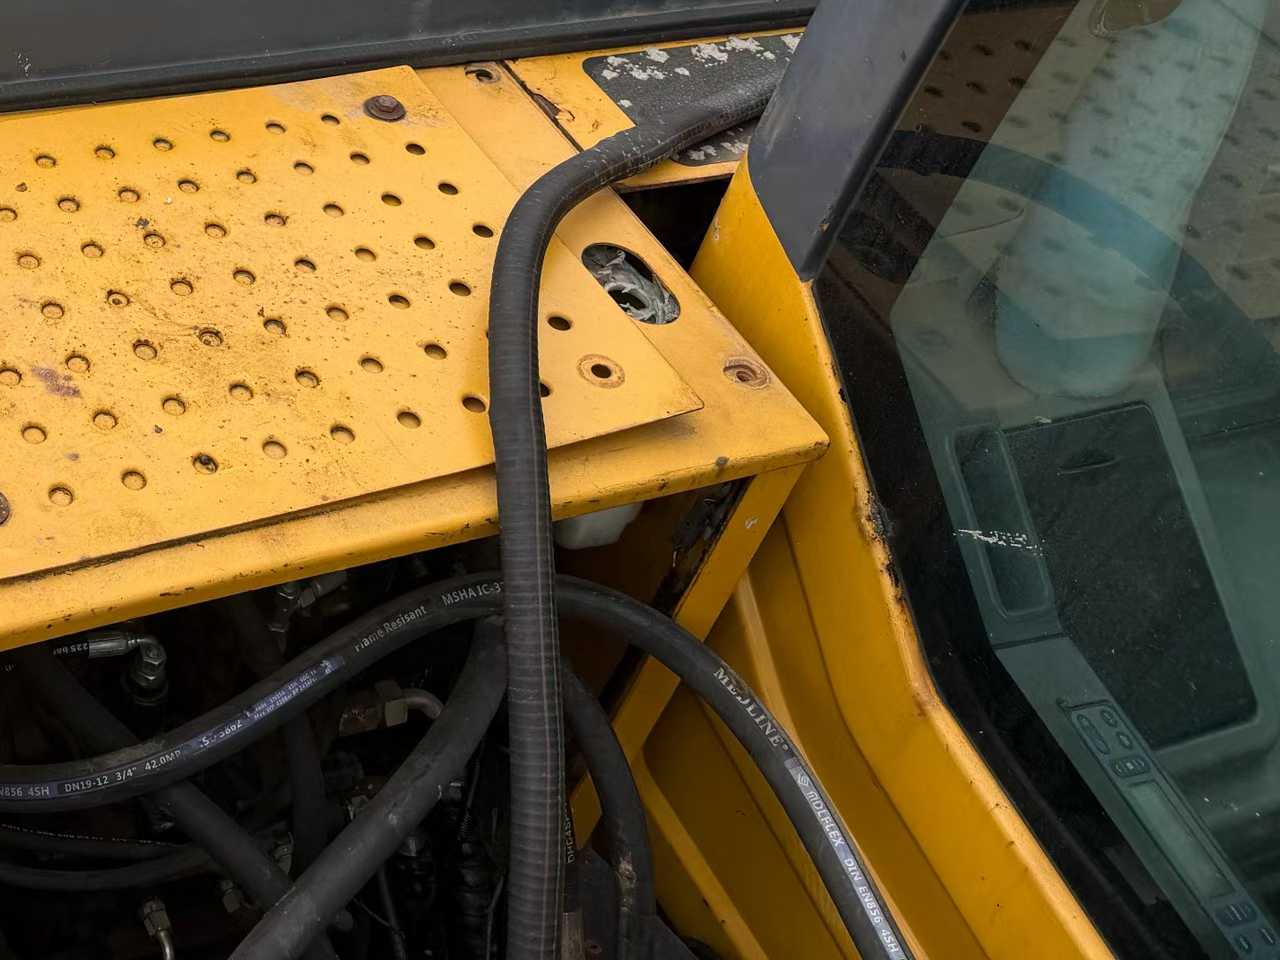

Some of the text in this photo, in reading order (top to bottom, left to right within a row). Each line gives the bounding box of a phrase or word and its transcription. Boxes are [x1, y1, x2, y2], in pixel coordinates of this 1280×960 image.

[441, 585, 477, 607] MSHA
[64, 775, 109, 793] DN19-12
[844, 858, 863, 882] DIN
[859, 886, 884, 924] EN856
